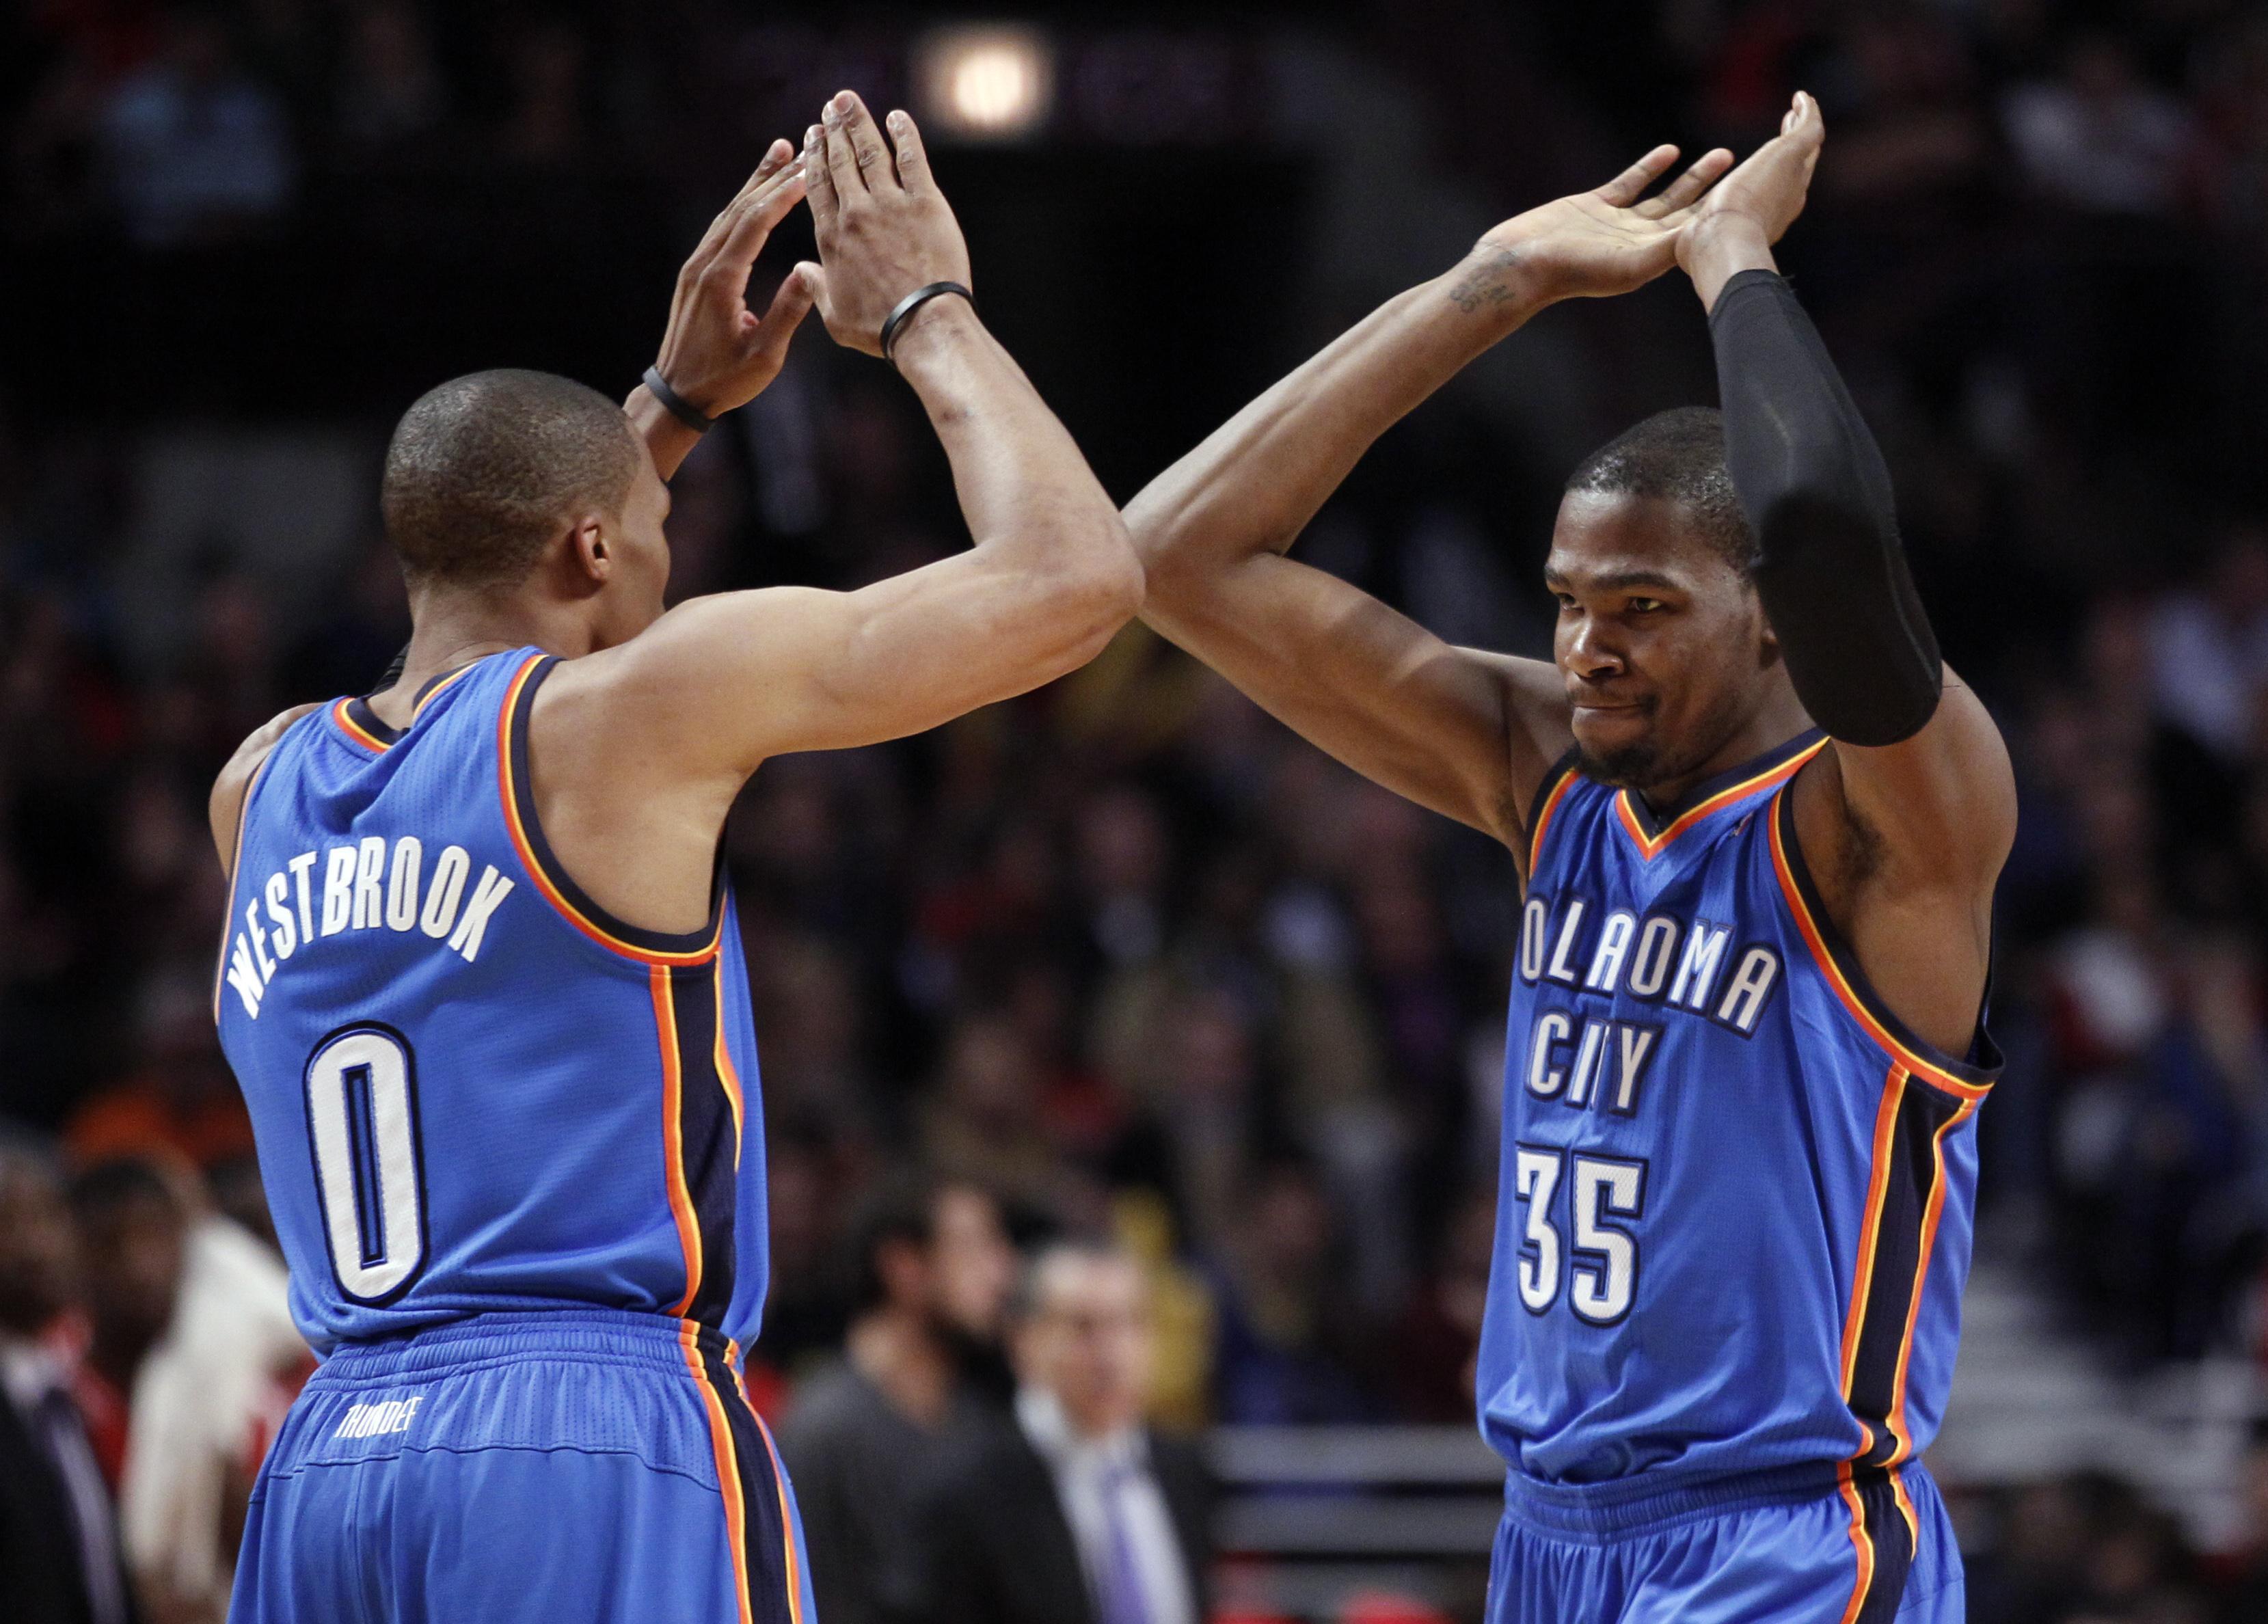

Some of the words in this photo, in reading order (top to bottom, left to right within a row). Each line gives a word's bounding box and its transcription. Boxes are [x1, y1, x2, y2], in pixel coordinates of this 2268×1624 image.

[226, 835, 515, 1020] WESTBROOK
[1520, 897, 1780, 1034] OLAOMA
[1526, 1010, 1657, 1114] CIY
[303, 1020, 429, 1306] 0
[1515, 1143, 1647, 1325] 35
